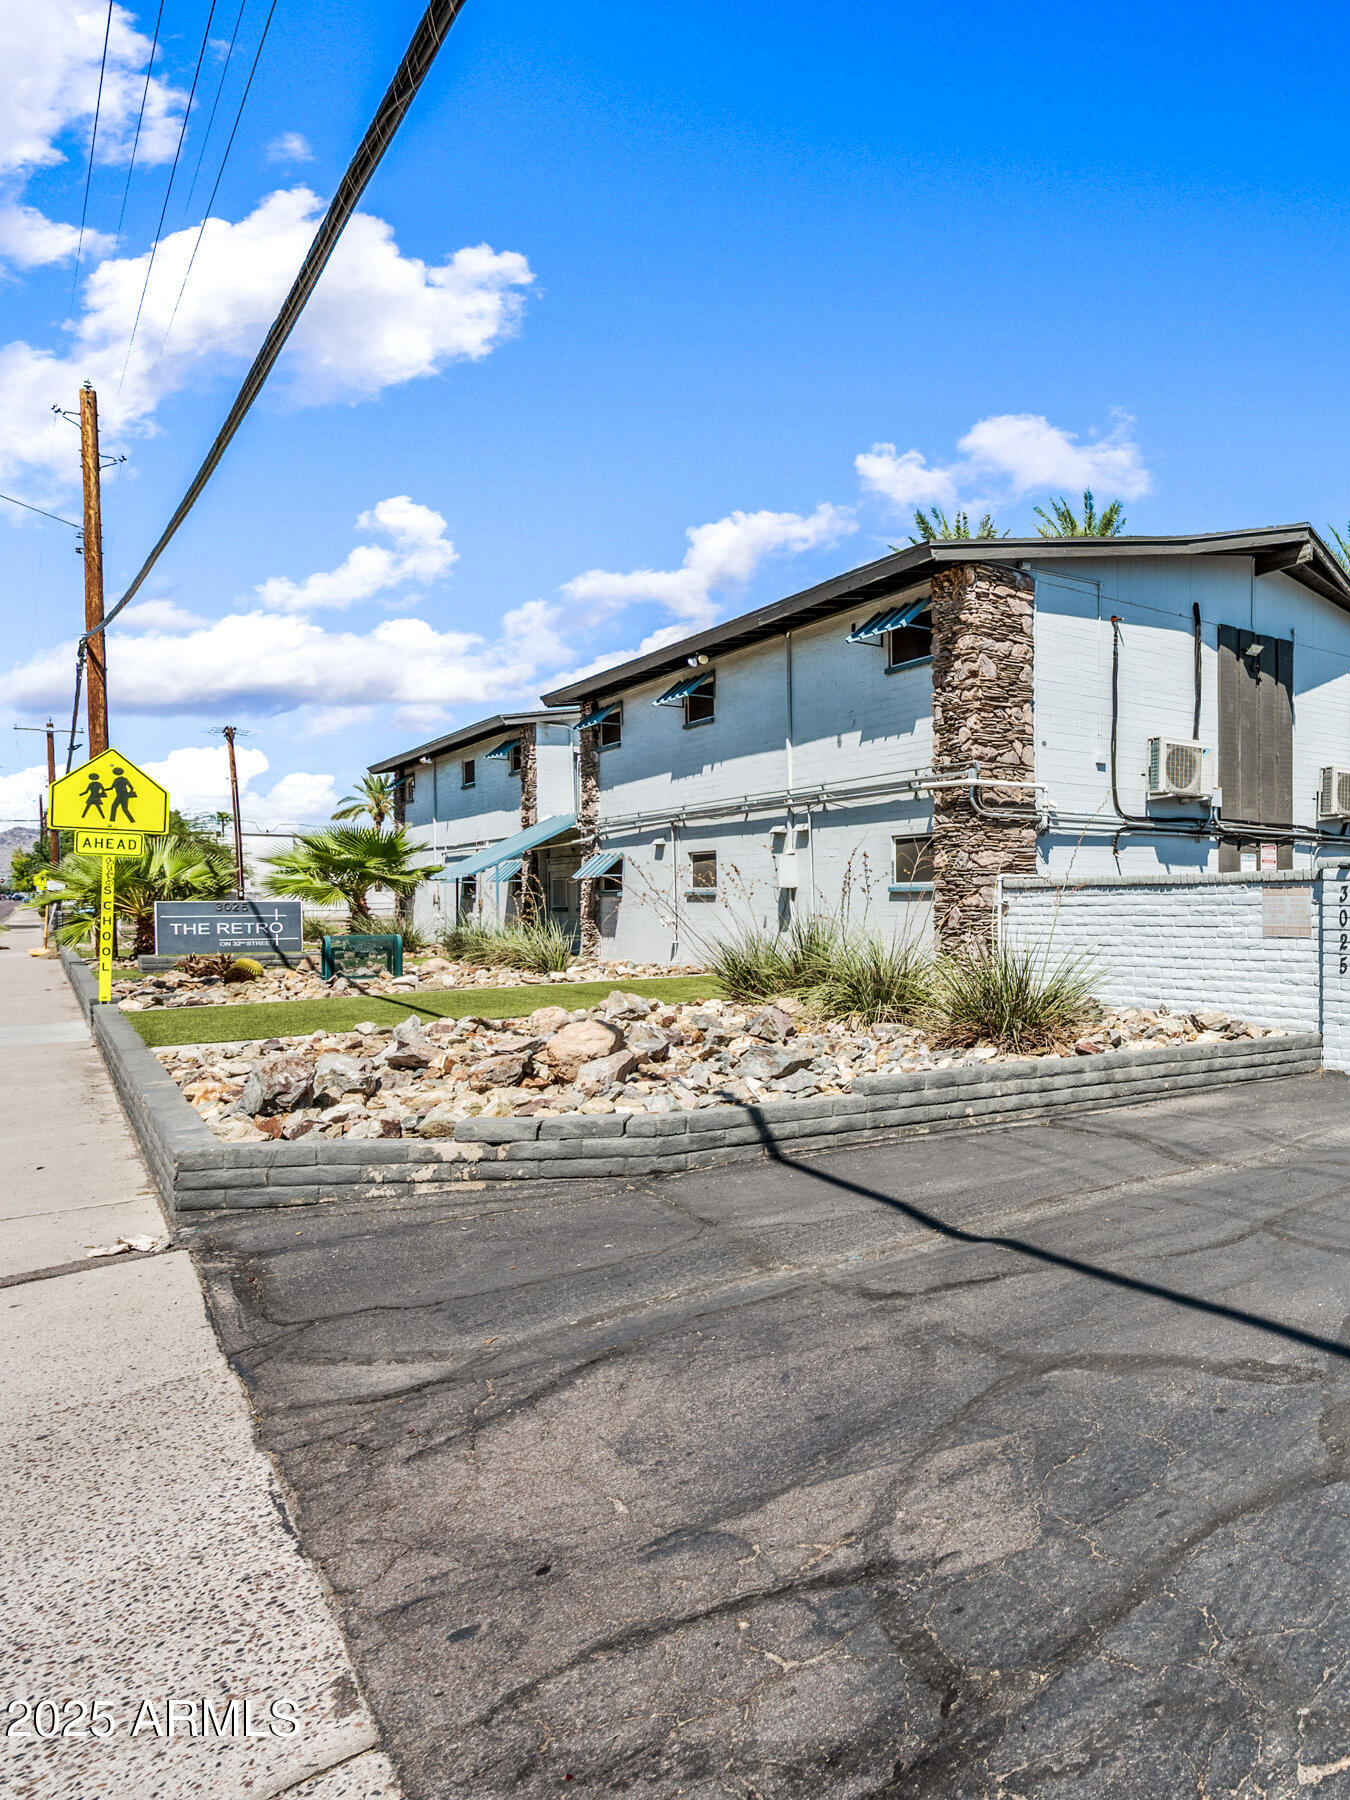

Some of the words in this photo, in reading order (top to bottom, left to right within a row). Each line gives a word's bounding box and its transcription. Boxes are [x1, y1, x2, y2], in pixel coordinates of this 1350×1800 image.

[82, 837, 137, 850] AHEAD
[215, 902, 249, 912] 3025
[101, 886, 112, 971] SCHOOL
[169, 922, 211, 936] THE
[216, 922, 284, 935] RETRO
[1339, 885, 1349, 974] 3025
